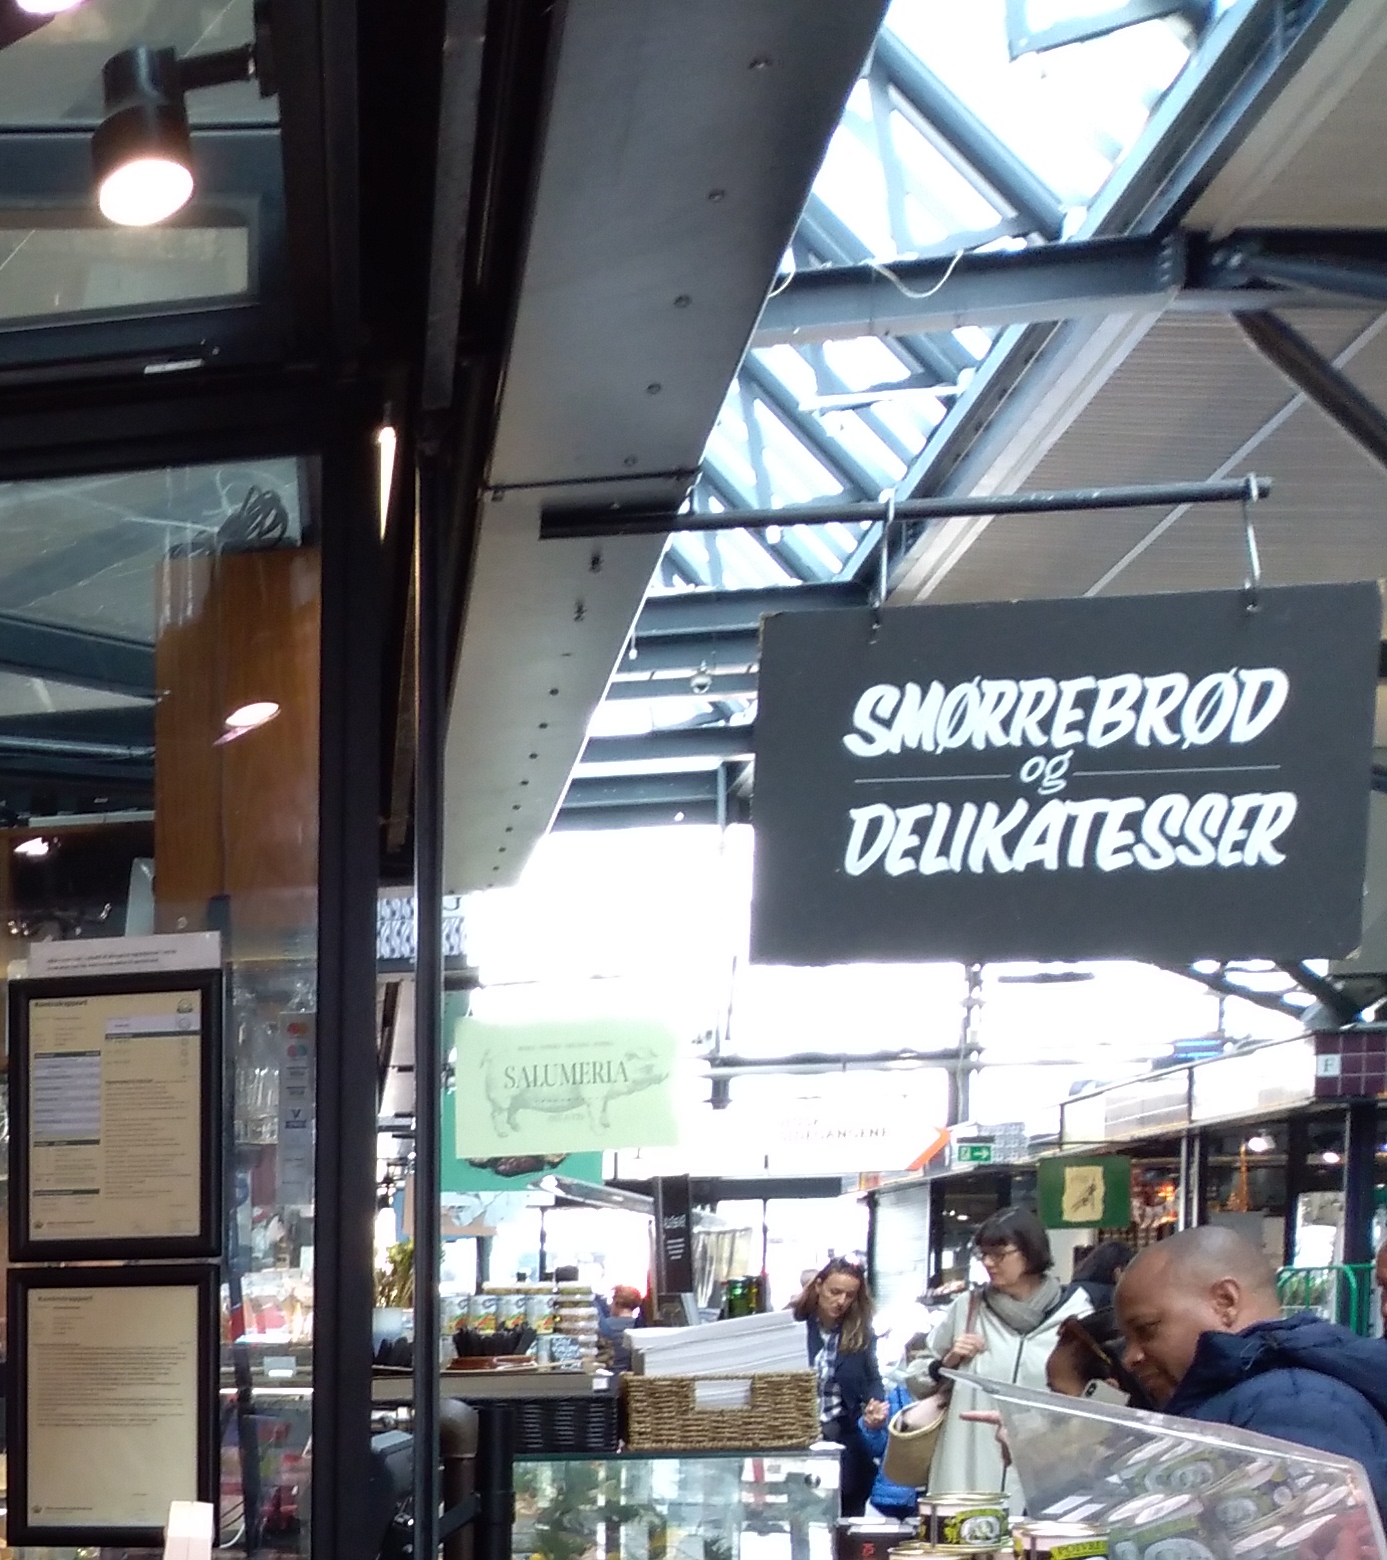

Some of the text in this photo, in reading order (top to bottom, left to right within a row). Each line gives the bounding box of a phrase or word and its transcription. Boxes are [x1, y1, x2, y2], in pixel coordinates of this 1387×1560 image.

[843, 666, 1290, 758] SMØRREBRØD
[1019, 749, 1075, 795] og
[843, 792, 1297, 876] DELIKATESSER
[503, 1059, 629, 1090] SALUMERIA
